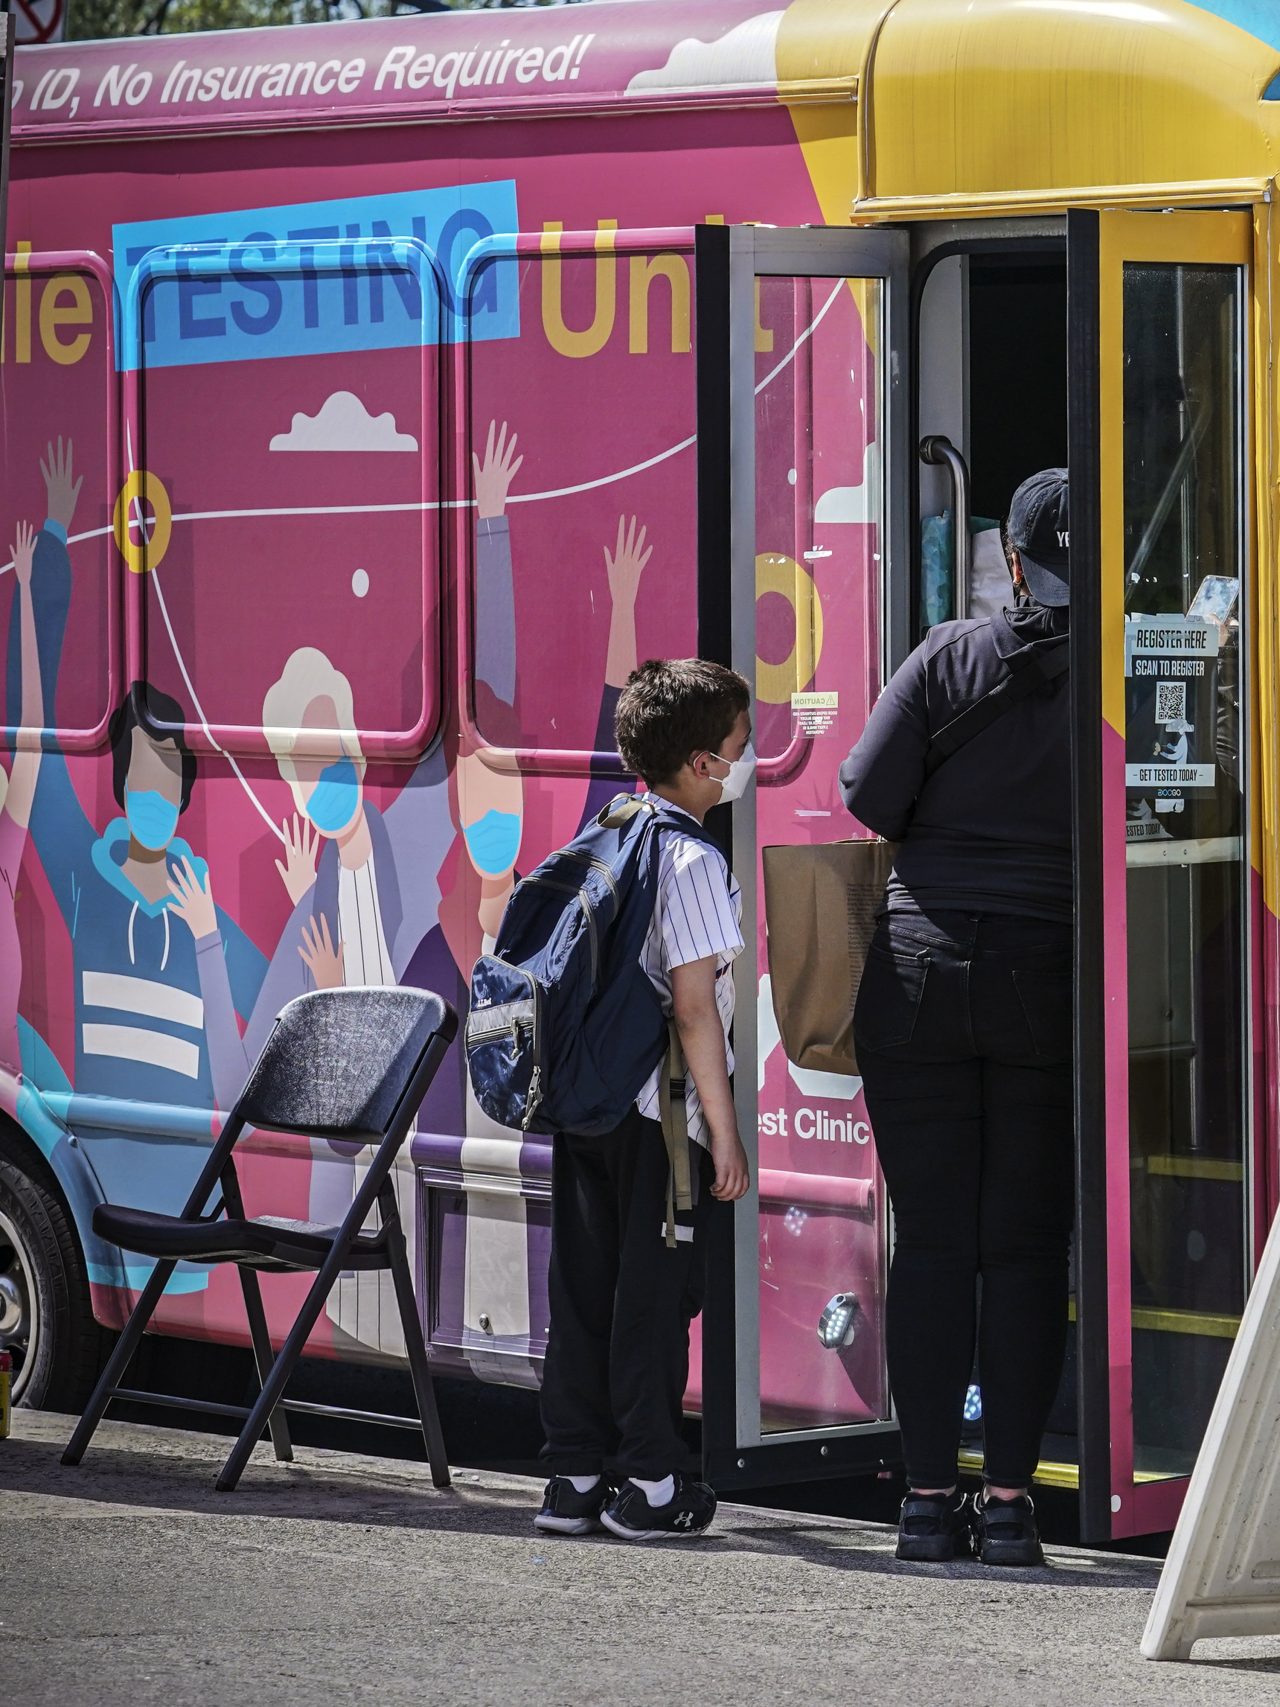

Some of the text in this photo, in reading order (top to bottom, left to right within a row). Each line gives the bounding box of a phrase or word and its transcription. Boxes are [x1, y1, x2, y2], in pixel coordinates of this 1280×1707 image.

[30, 68, 80, 119] ID,
[93, 63, 153, 107] No
[162, 55, 361, 103] Insurance
[373, 33, 595, 98] Required!
[125, 208, 498, 344] TESTING
[1136, 629, 1207, 649] REGISTER HERE
[1135, 660, 1205, 676] SCAN TO REGISTER
[1140, 769, 1198, 781] GET TESTED TODAY
[794, 1108, 870, 1144] Clinic
